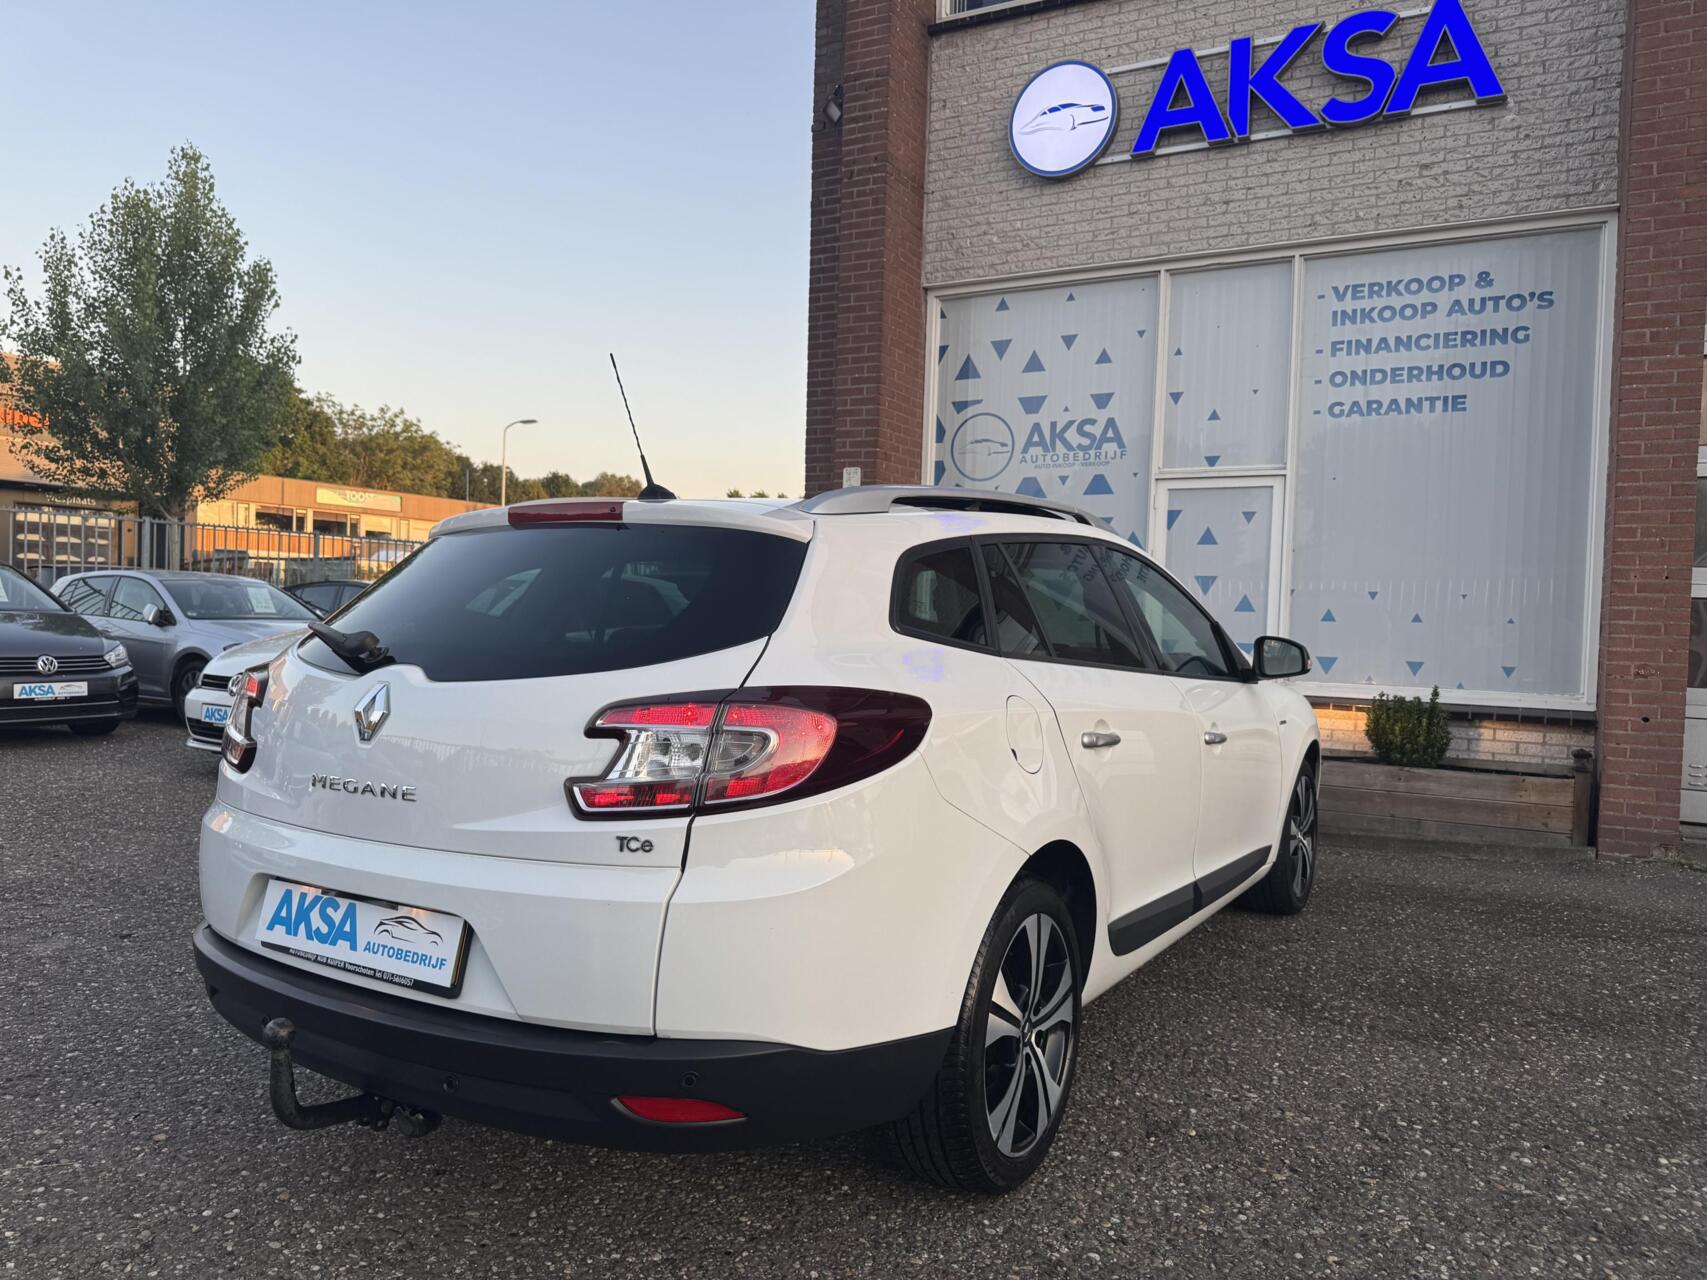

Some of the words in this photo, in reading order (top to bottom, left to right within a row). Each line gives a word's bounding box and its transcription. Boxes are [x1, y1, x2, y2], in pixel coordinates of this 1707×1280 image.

[1130, 0, 1506, 157] AKSA
[1331, 274, 1466, 302] VERKOOP
[1474, 271, 1494, 289] &
[1331, 302, 1438, 327] INKOOP
[1330, 326, 1530, 357] FINANCIERING
[1329, 360, 1510, 388] ONDERHOUD
[1328, 394, 1467, 418] GARANTIE
[1020, 417, 1126, 454] AKSA
[1019, 450, 1127, 464] AUTOBEDRIJF
[18, 684, 56, 697] AKSA
[204, 707, 229, 722] AKSA
[310, 773, 417, 802] MEGANE
[615, 836, 654, 853] TCe
[266, 888, 359, 952] AKSA
[363, 941, 447, 971] AUTOBEDRIJF
